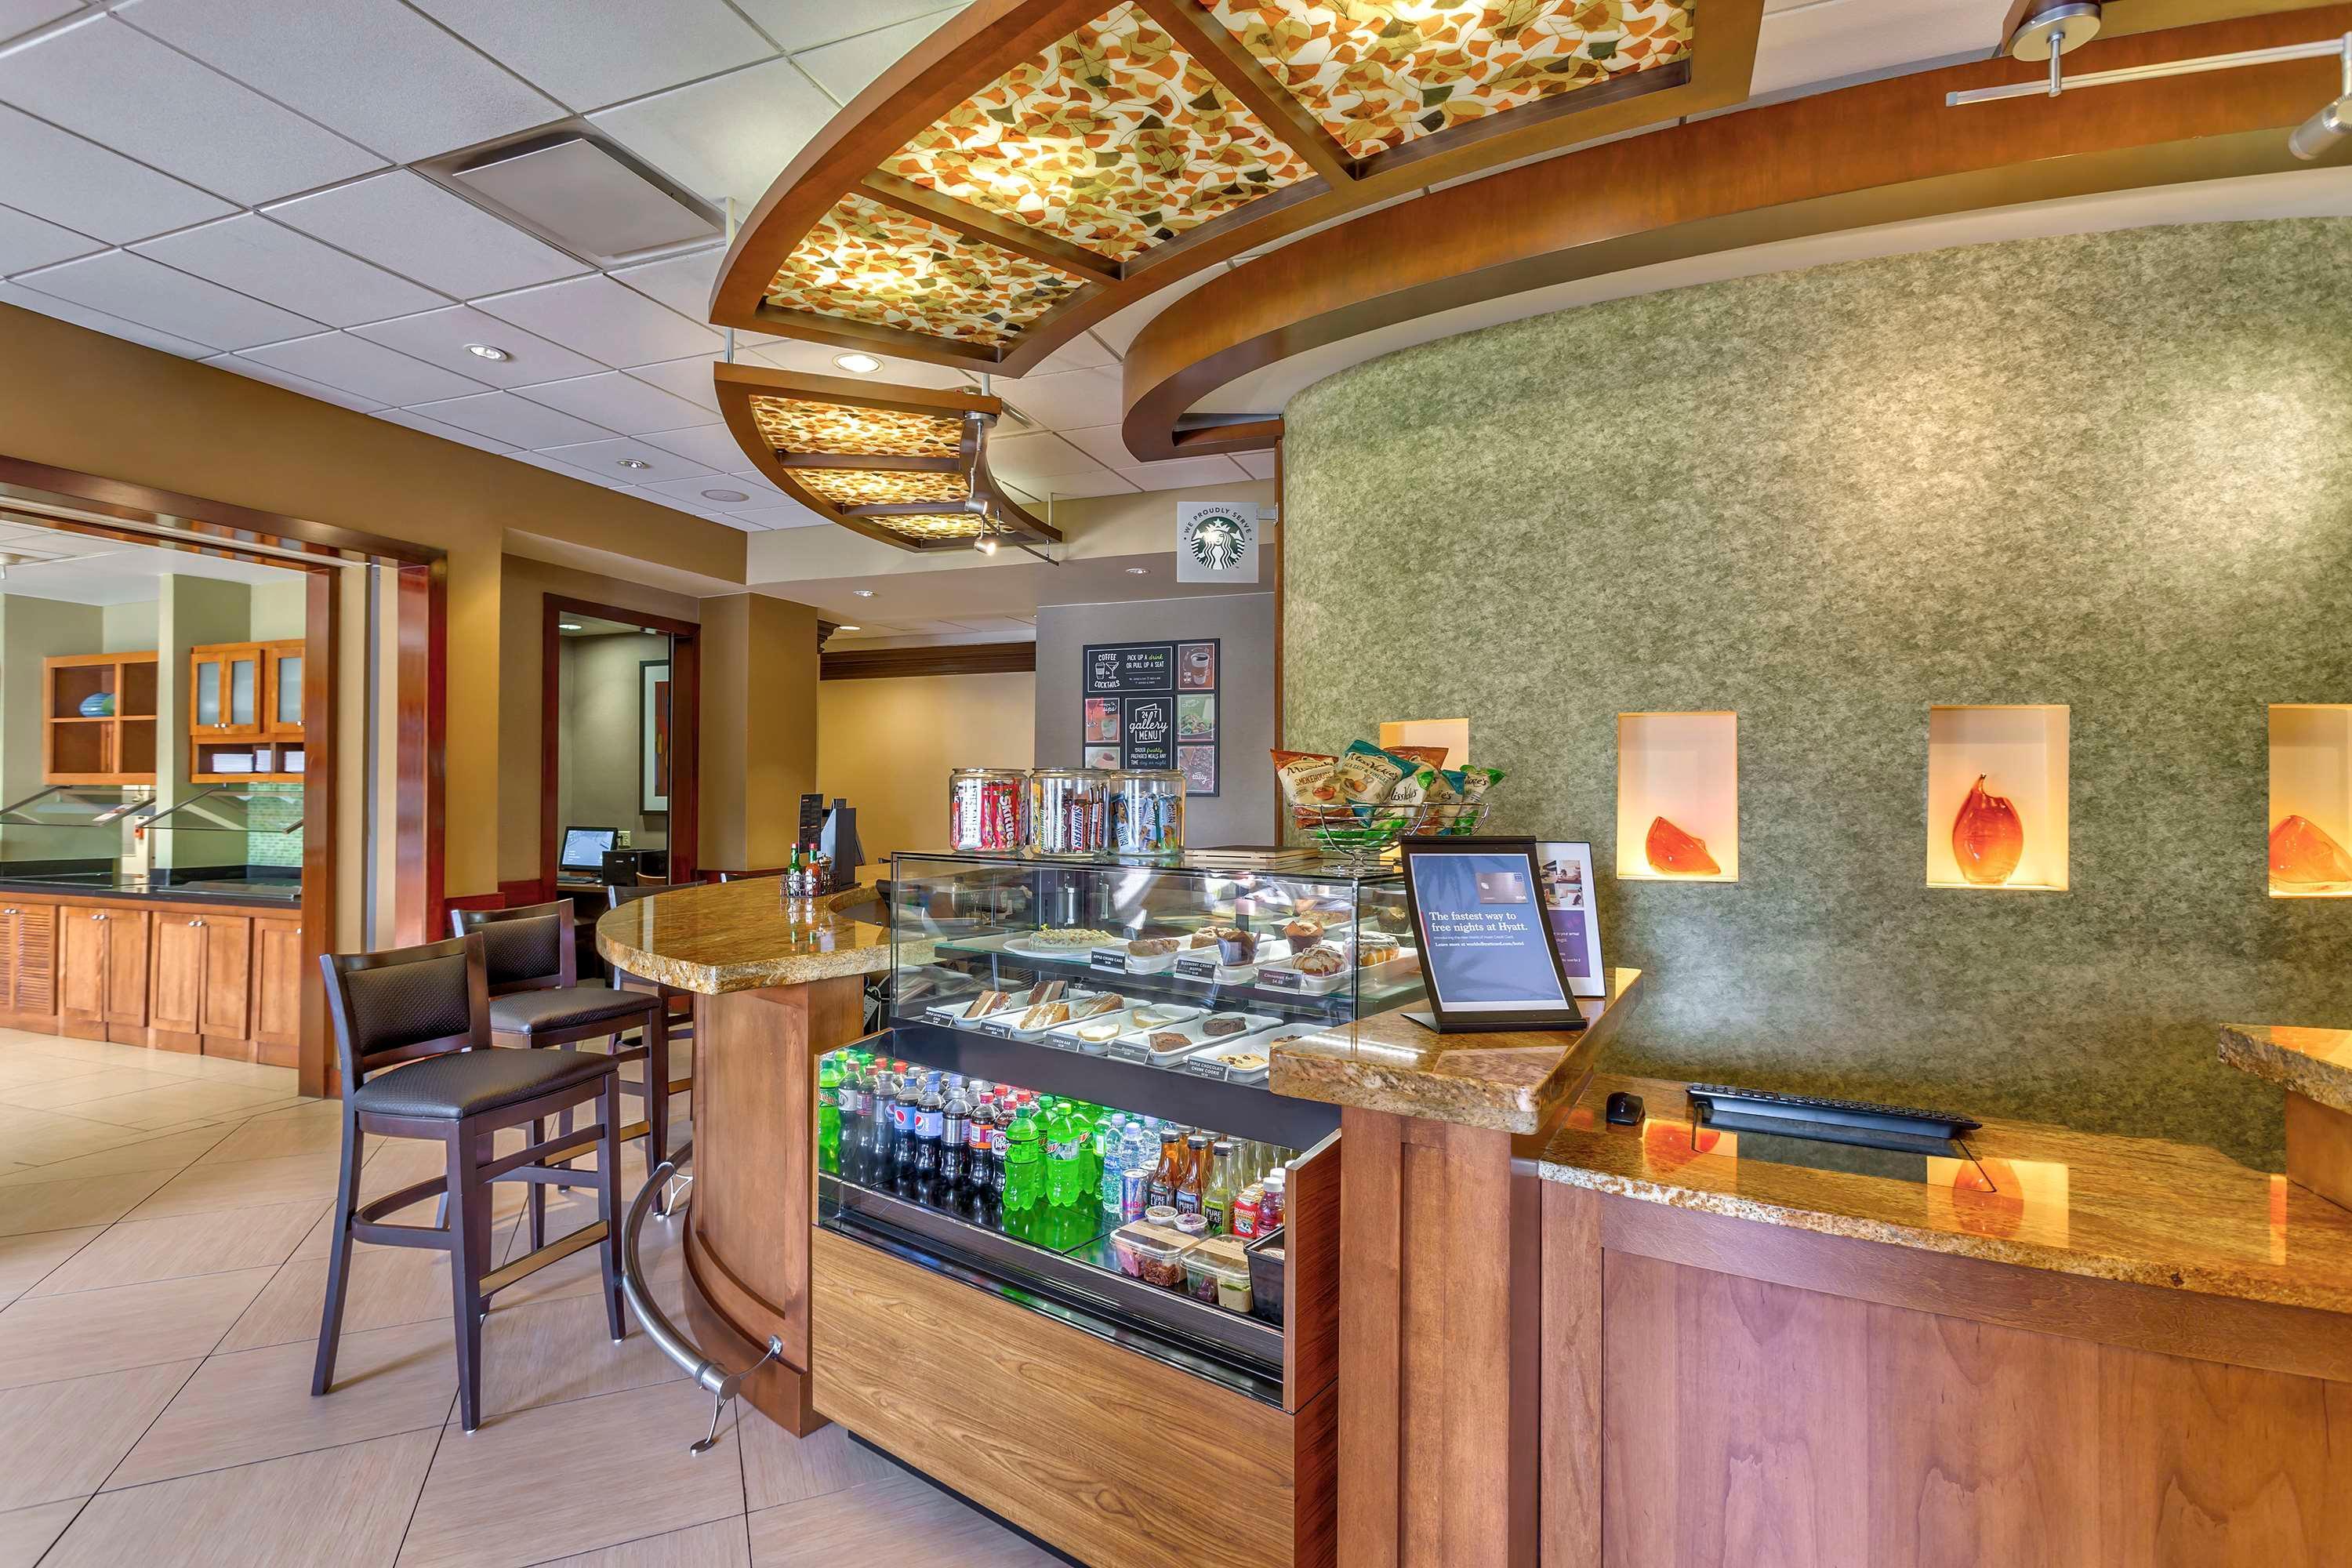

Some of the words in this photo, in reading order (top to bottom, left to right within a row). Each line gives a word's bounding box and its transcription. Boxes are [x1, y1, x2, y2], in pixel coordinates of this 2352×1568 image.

[1184, 521, 1193, 534] WE
[1192, 507, 1230, 521] PROUDLY
[1231, 512, 1252, 534] SERVE
[1094, 680, 1120, 688] COCKTAILS
[1129, 711, 1168, 734] gallery
[1139, 730, 1157, 740] MENU
[1294, 771, 1332, 786] SMOKEHOUSE
[1370, 771, 1389, 786] VINEGAR
[999, 795, 1014, 848] Skittles
[1073, 806, 1083, 847] SNICKERS
[1428, 912, 1449, 920] The
[1450, 912, 1483, 920] fastest
[1505, 912, 1516, 920] to
[1431, 923, 1452, 931] free
[1454, 922, 1484, 933] nights
[1498, 922, 1529, 933] Hyatt.
[1179, 1201, 1193, 1210] PURE
[1206, 1208, 1221, 1217] PURE
[1234, 1207, 1256, 1218] HORIZON
[1206, 1214, 1221, 1224] LEAF
